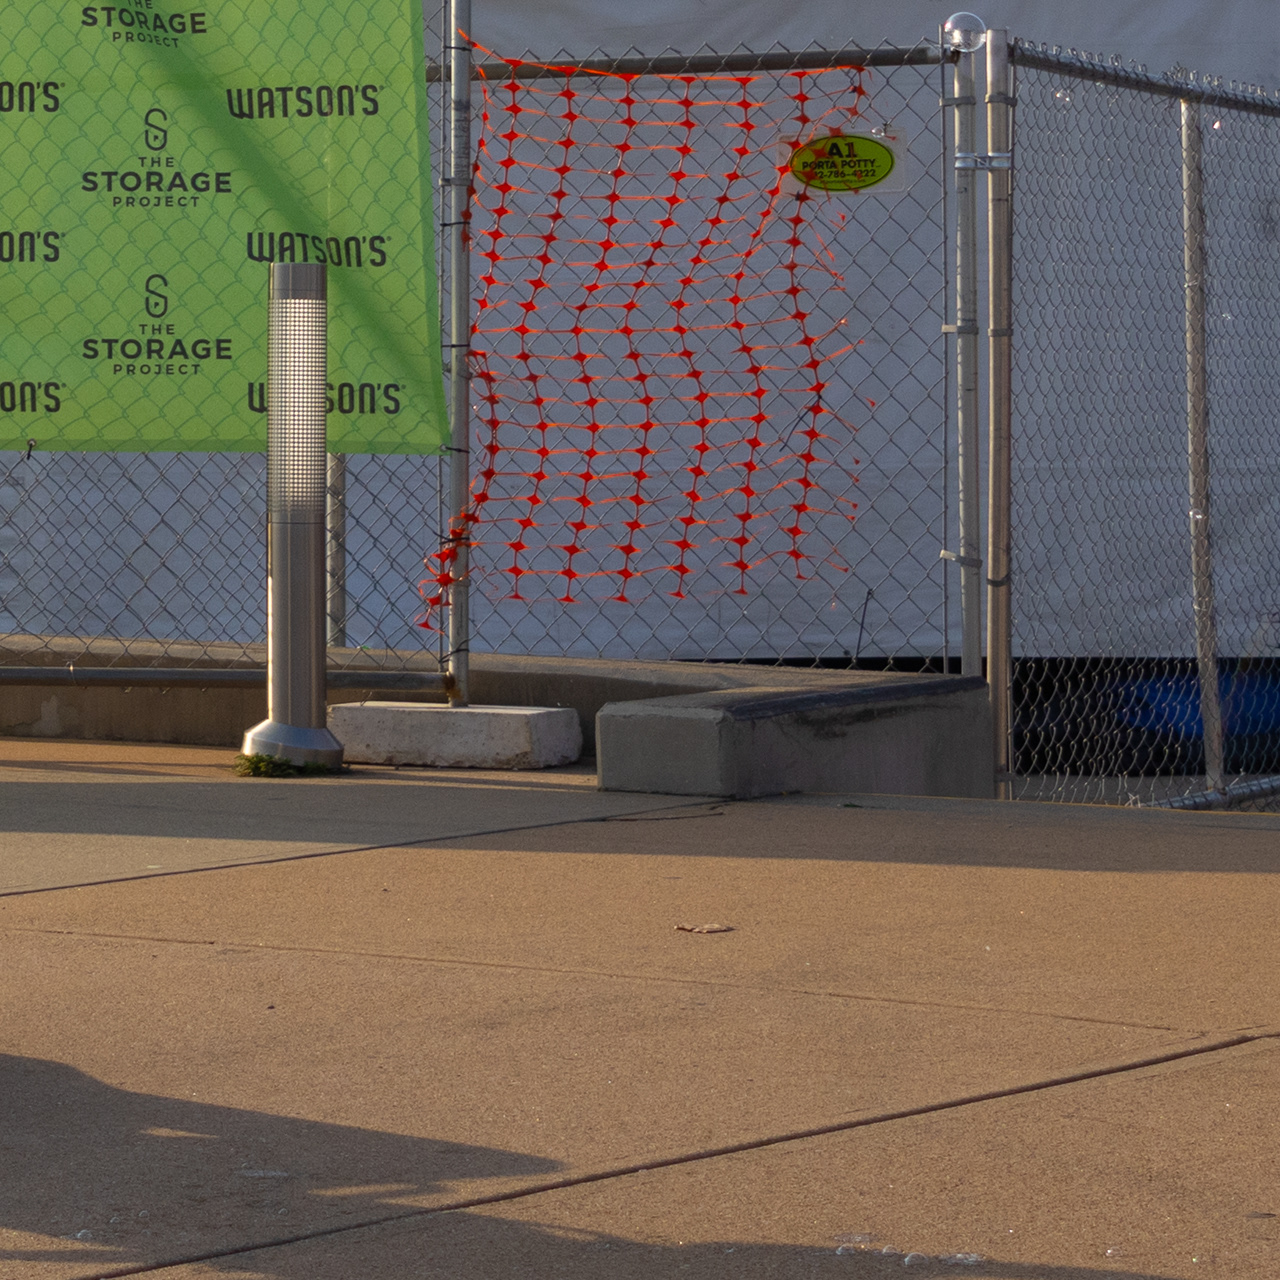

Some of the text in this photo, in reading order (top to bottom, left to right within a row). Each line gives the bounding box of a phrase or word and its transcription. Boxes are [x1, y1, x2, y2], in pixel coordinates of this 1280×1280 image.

[81, 6, 207, 34] STORAGE
[113, 31, 179, 48] PROJECT
[226, 85, 378, 119] WATSON'S
[828, 142, 857, 158] A1
[138, 157, 174, 167] THE
[802, 159, 875, 170] PORTA POTTY
[82, 171, 231, 193] STORAGE
[113, 196, 199, 207] PROJECT
[247, 232, 386, 267] WATSON'S
[139, 324, 174, 335] THE
[83, 339, 232, 359] STORAGE
[114, 364, 200, 375] PROJECT
[248, 382, 400, 414] WSON'S
